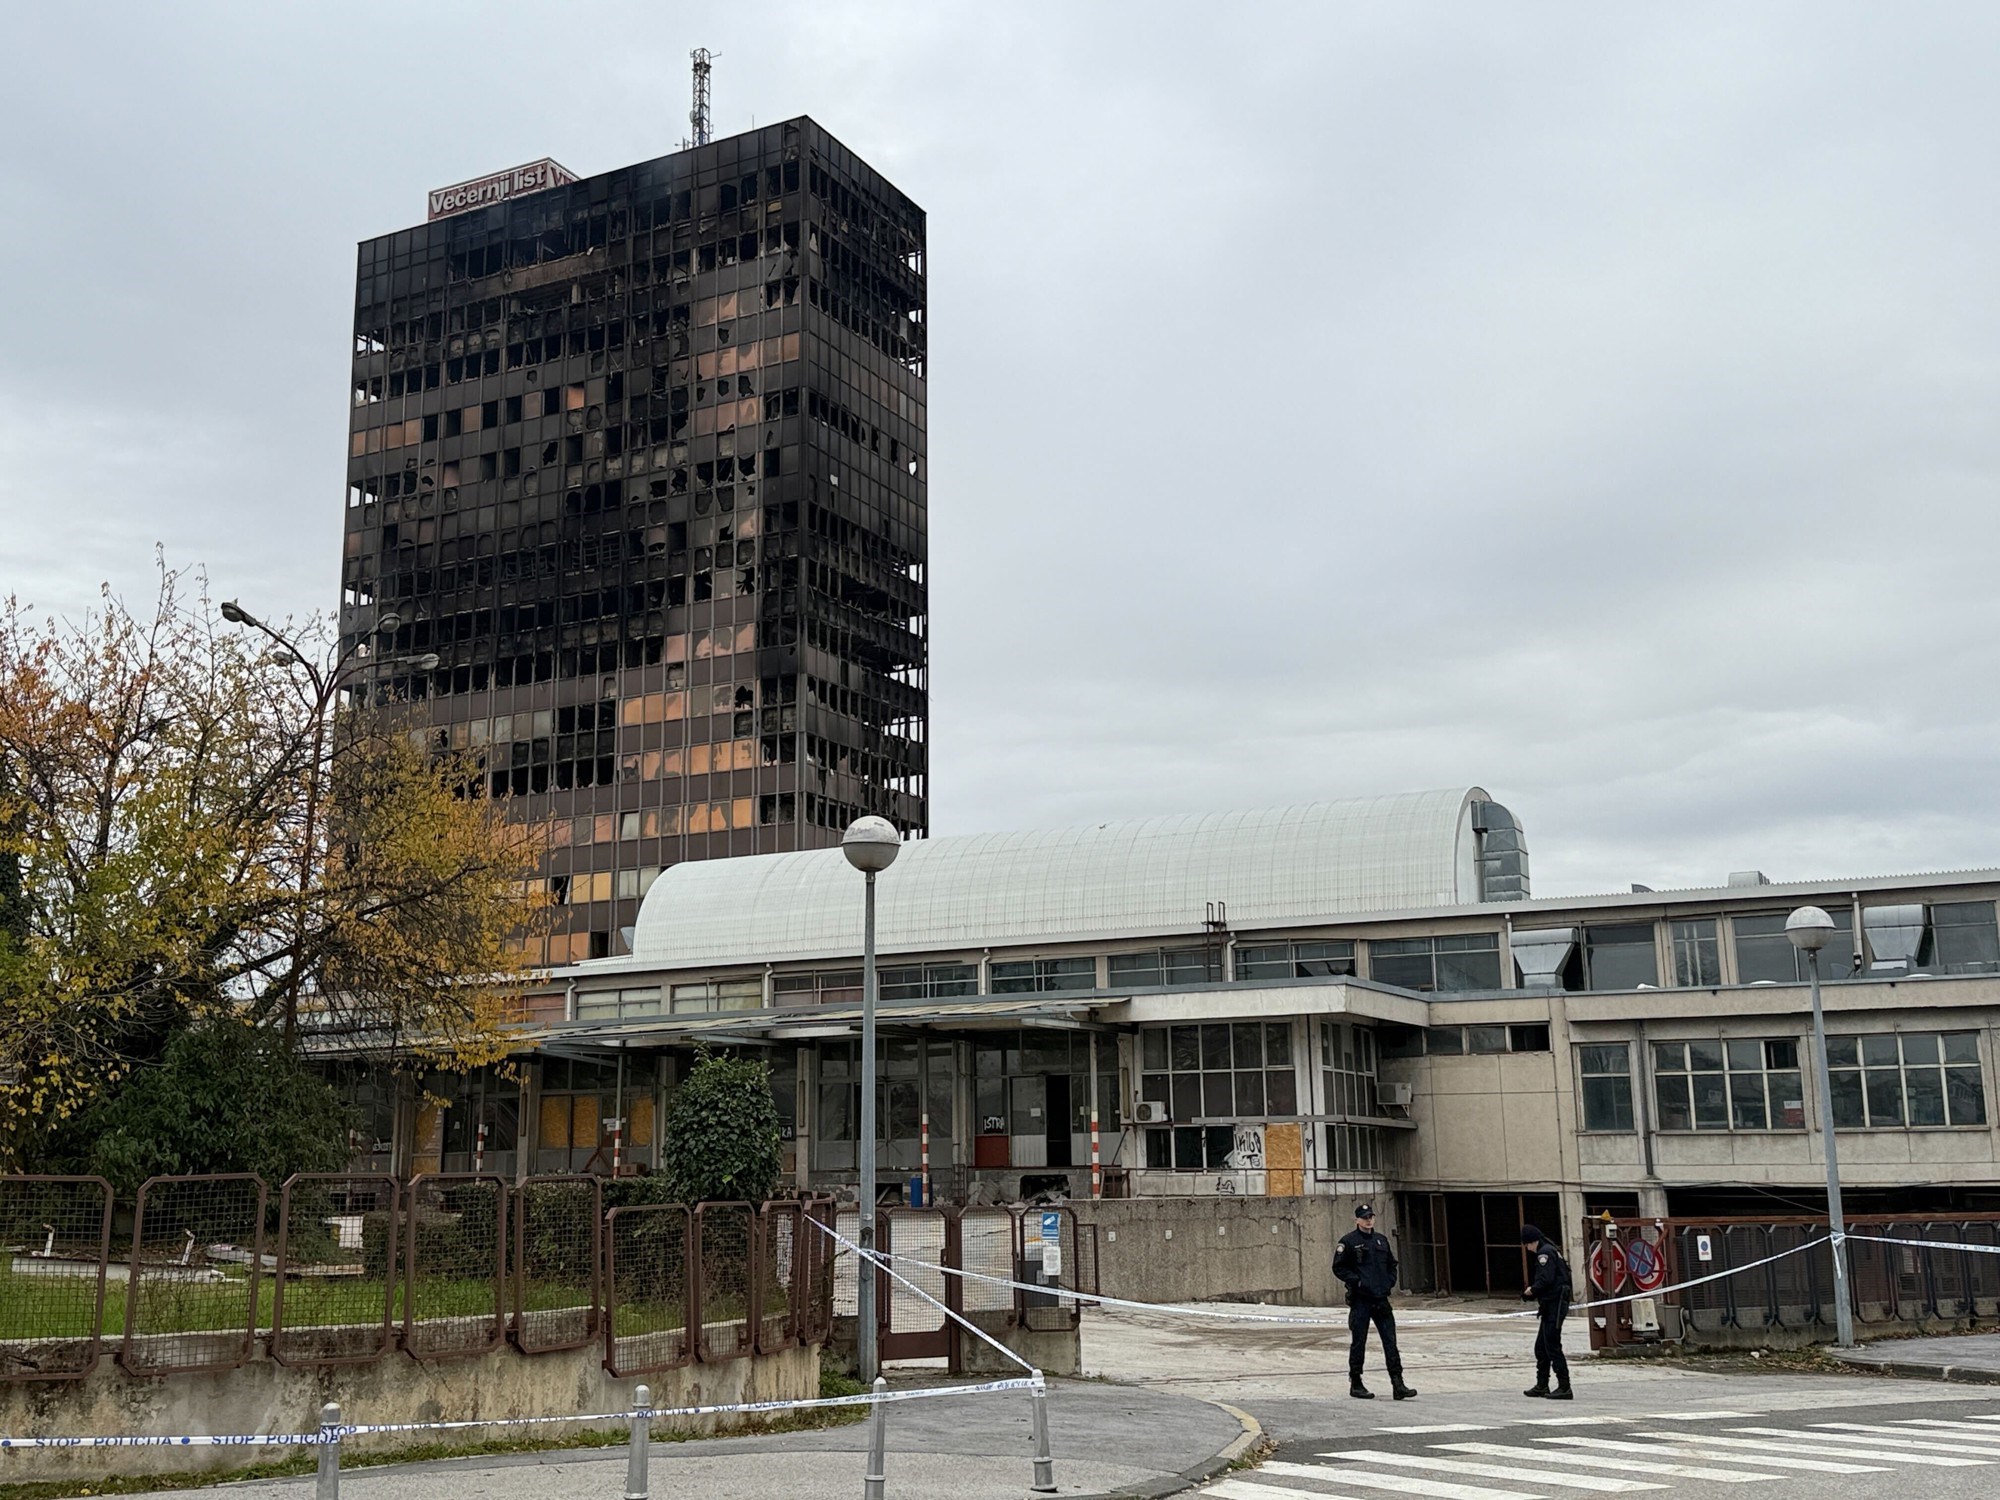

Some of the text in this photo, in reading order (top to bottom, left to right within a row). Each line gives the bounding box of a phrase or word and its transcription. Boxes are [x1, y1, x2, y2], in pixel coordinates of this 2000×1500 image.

[431, 174, 510, 214] Večernji
[514, 166, 546, 192] list
[1595, 1260, 1622, 1275] SP
[211, 1433, 338, 1445] STOP POLICIJA
